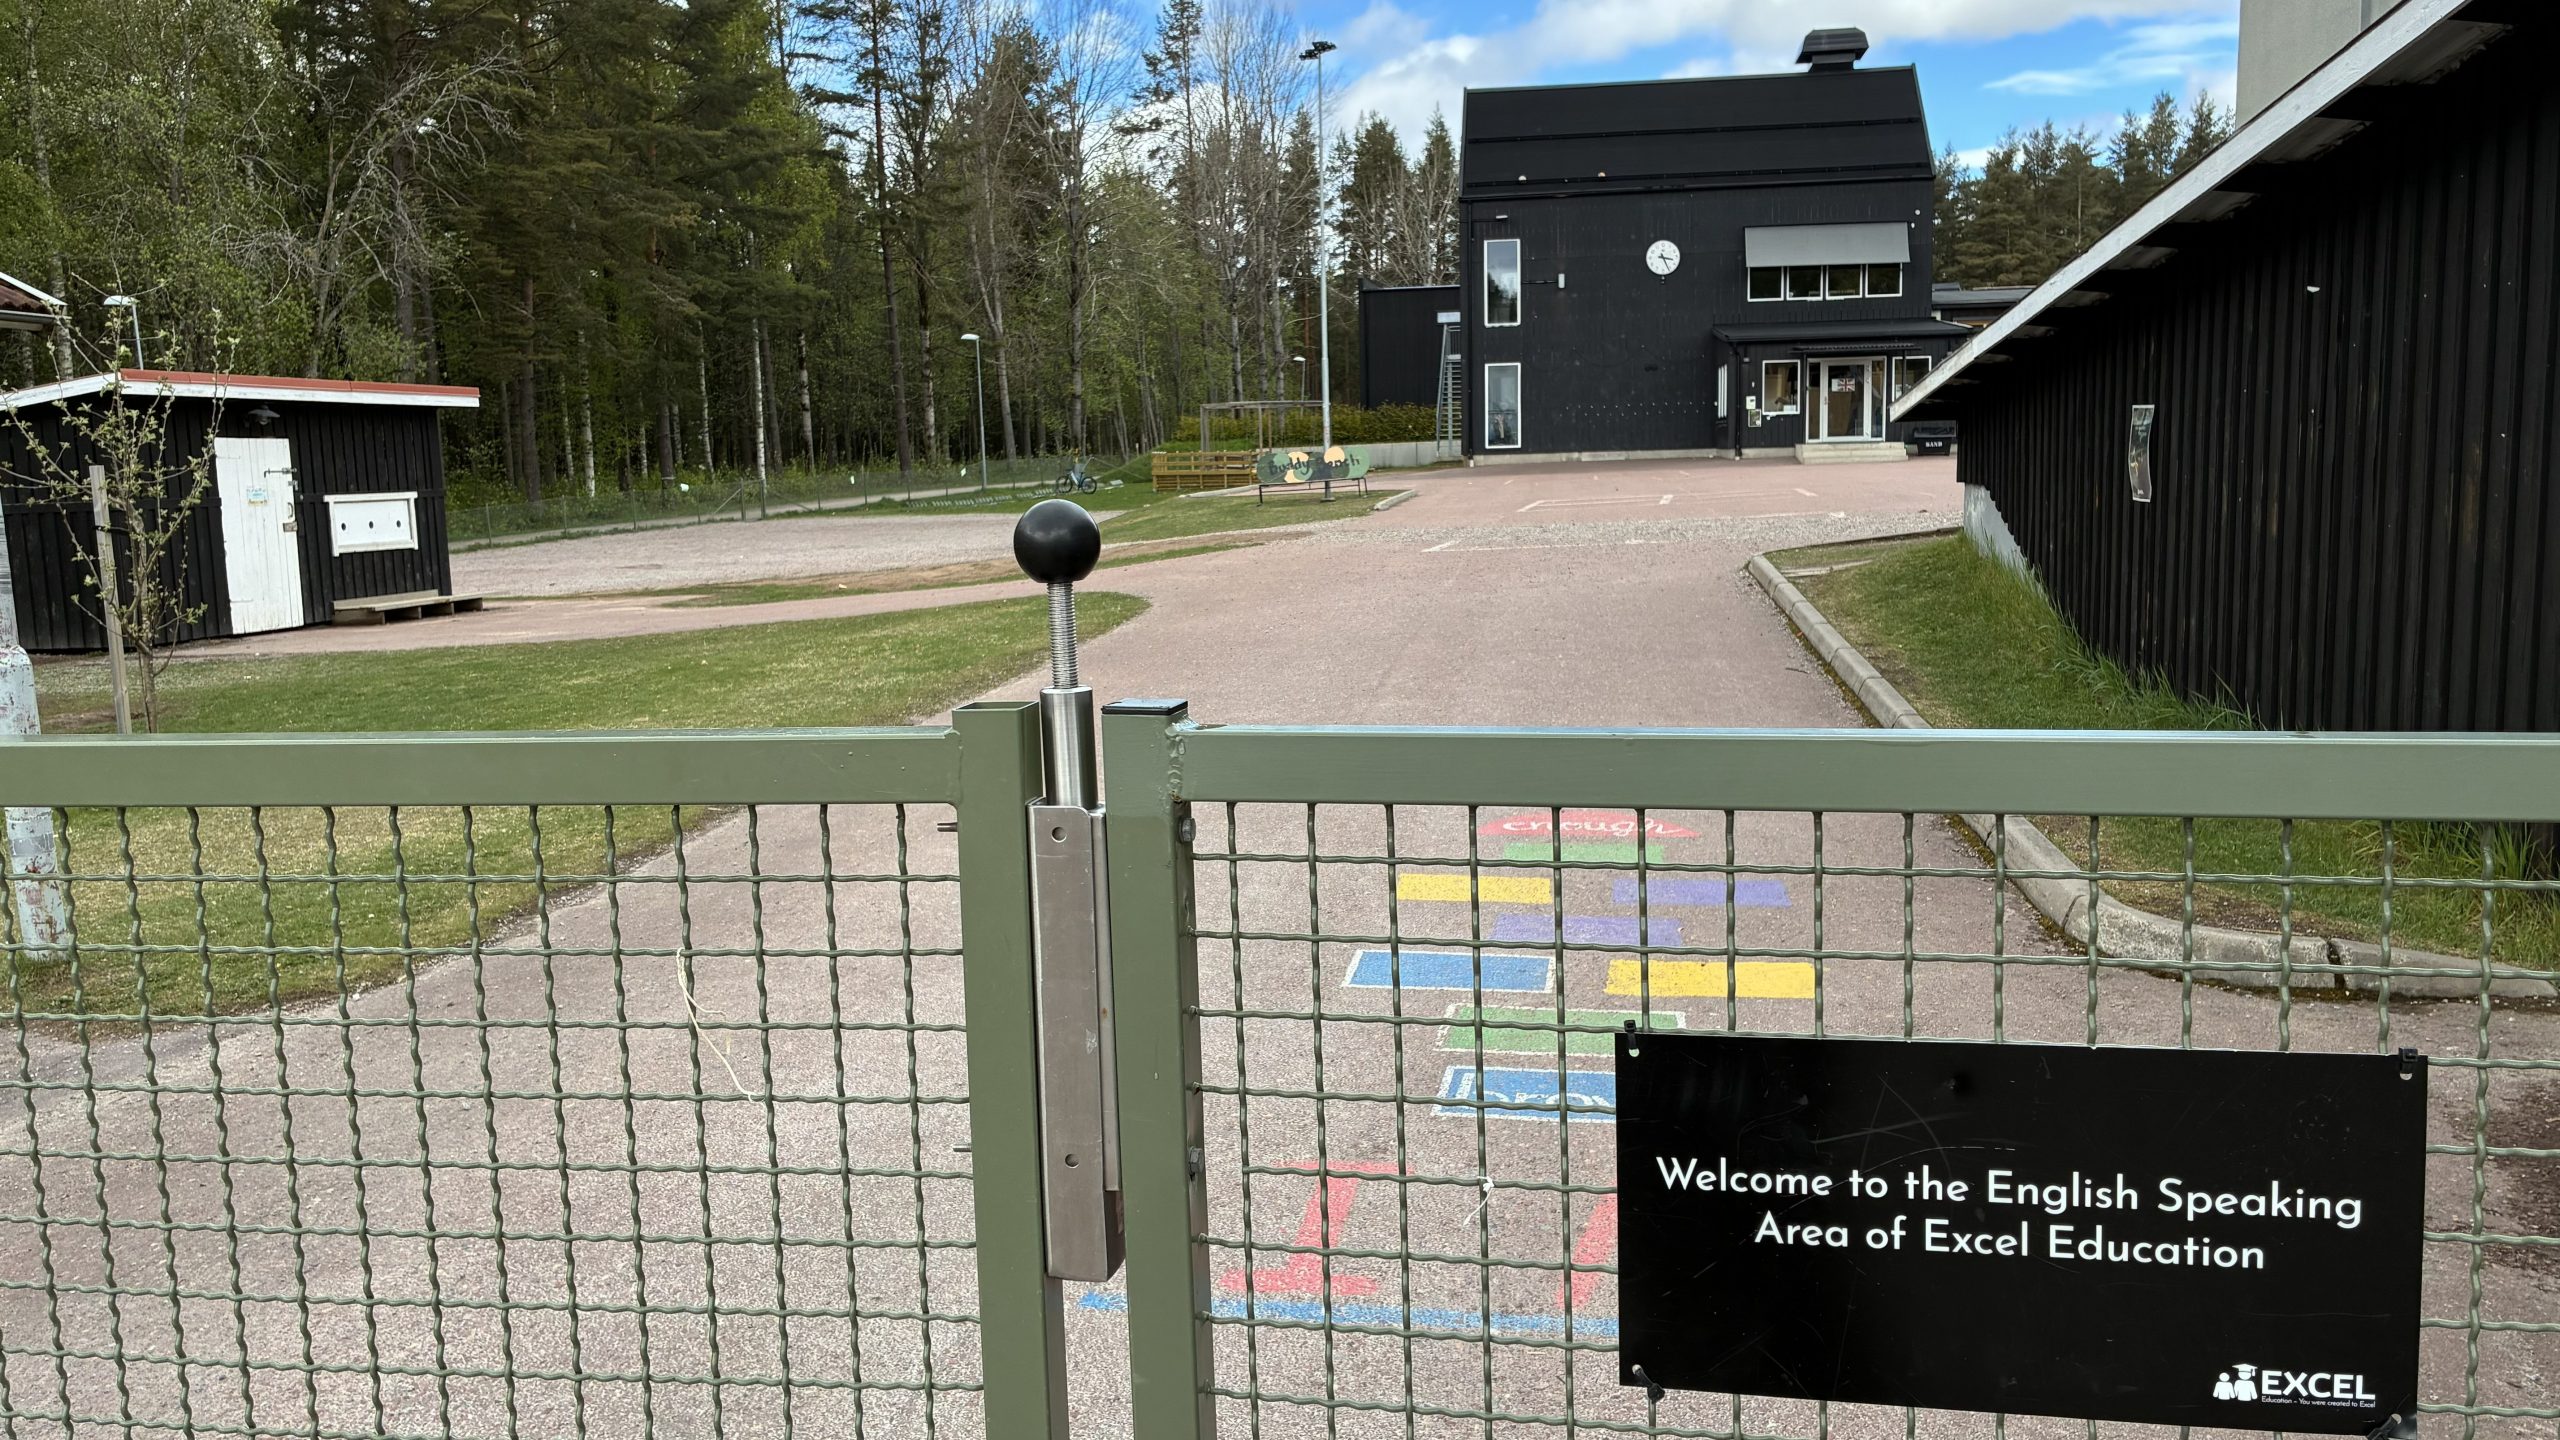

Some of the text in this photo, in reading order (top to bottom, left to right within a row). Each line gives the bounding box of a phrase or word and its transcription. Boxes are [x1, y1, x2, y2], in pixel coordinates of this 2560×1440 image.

[1269, 457, 1309, 476] Buddy
[1502, 817, 1682, 837] enough
[1656, 1157, 2361, 1228] Welcome to the English Speaking
[1755, 1211, 2263, 1269] Area of Excel Education
[2262, 1370, 2375, 1400] EXCEL
[2262, 1396, 2292, 1404] Education
